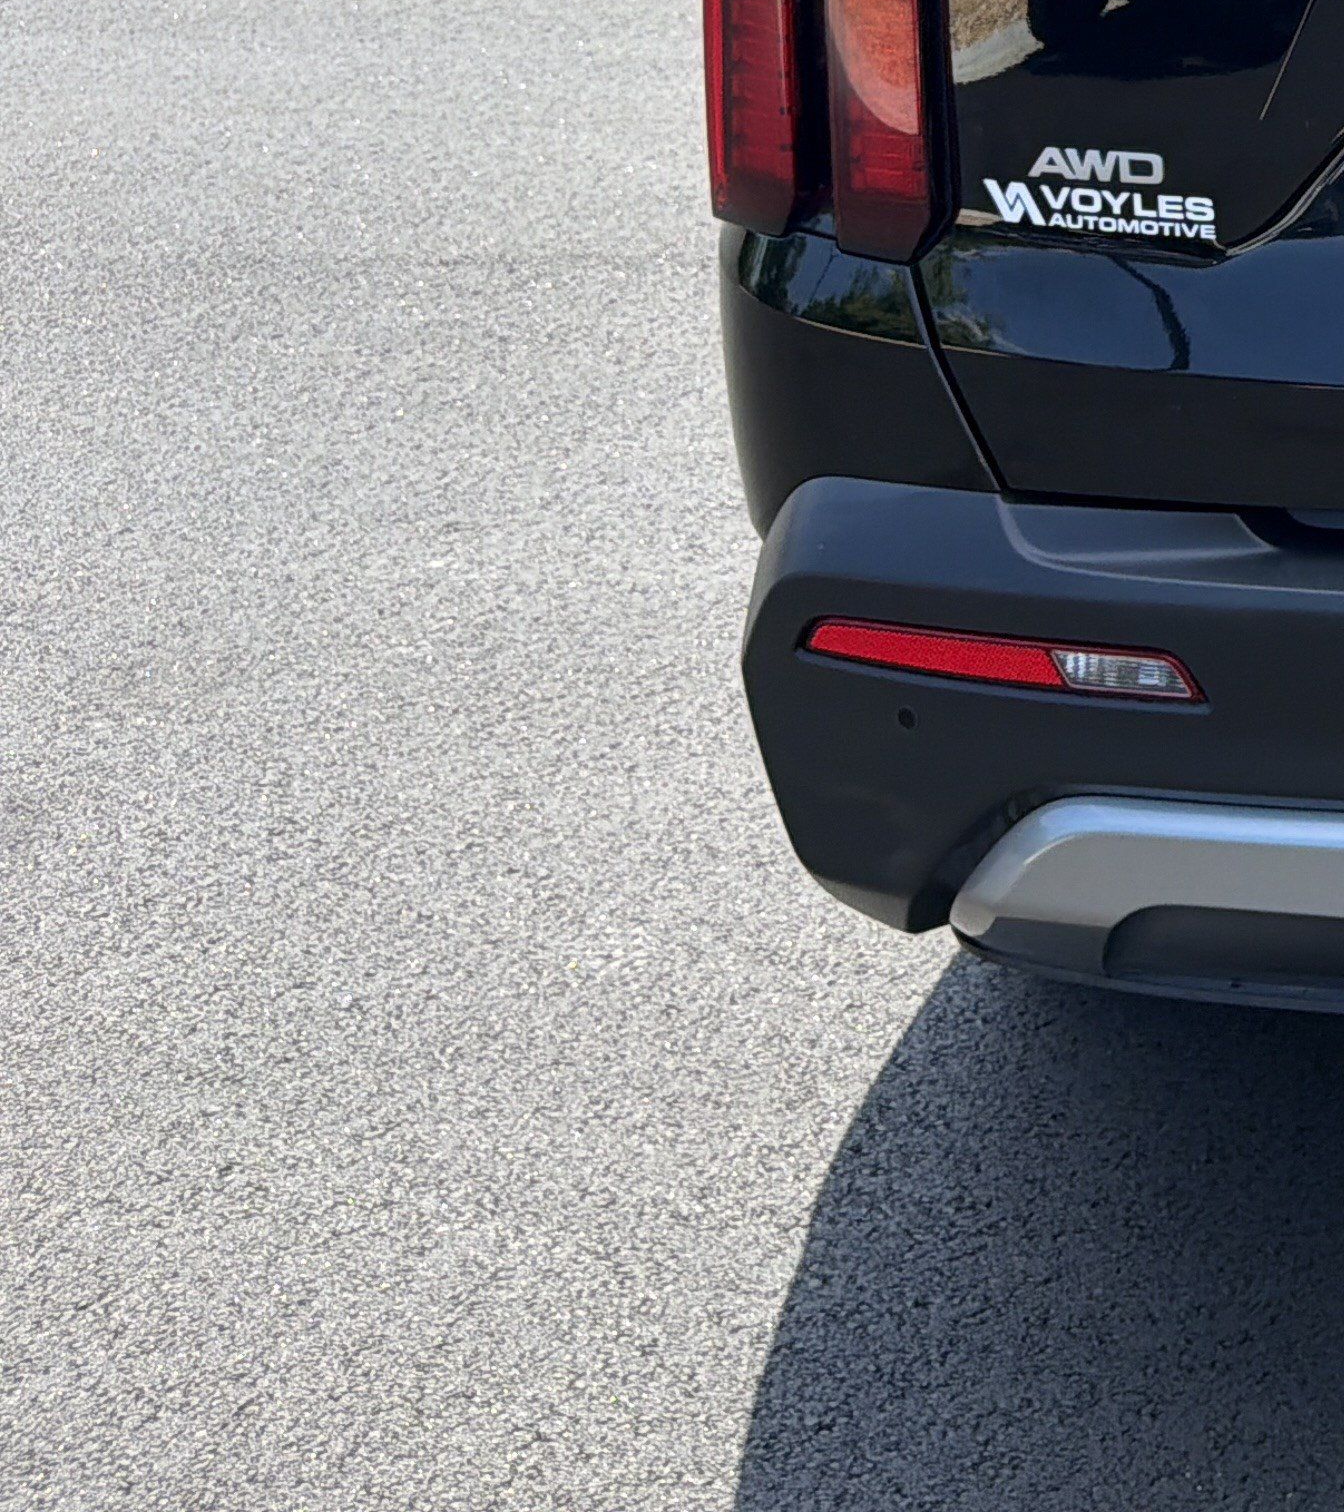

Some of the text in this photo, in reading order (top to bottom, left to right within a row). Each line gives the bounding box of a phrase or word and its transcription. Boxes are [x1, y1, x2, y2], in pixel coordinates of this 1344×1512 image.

[1027, 146, 1164, 185] AWD
[1040, 184, 1215, 222] VOYLES
[1047, 212, 1217, 240] AUTOMOTIVE
